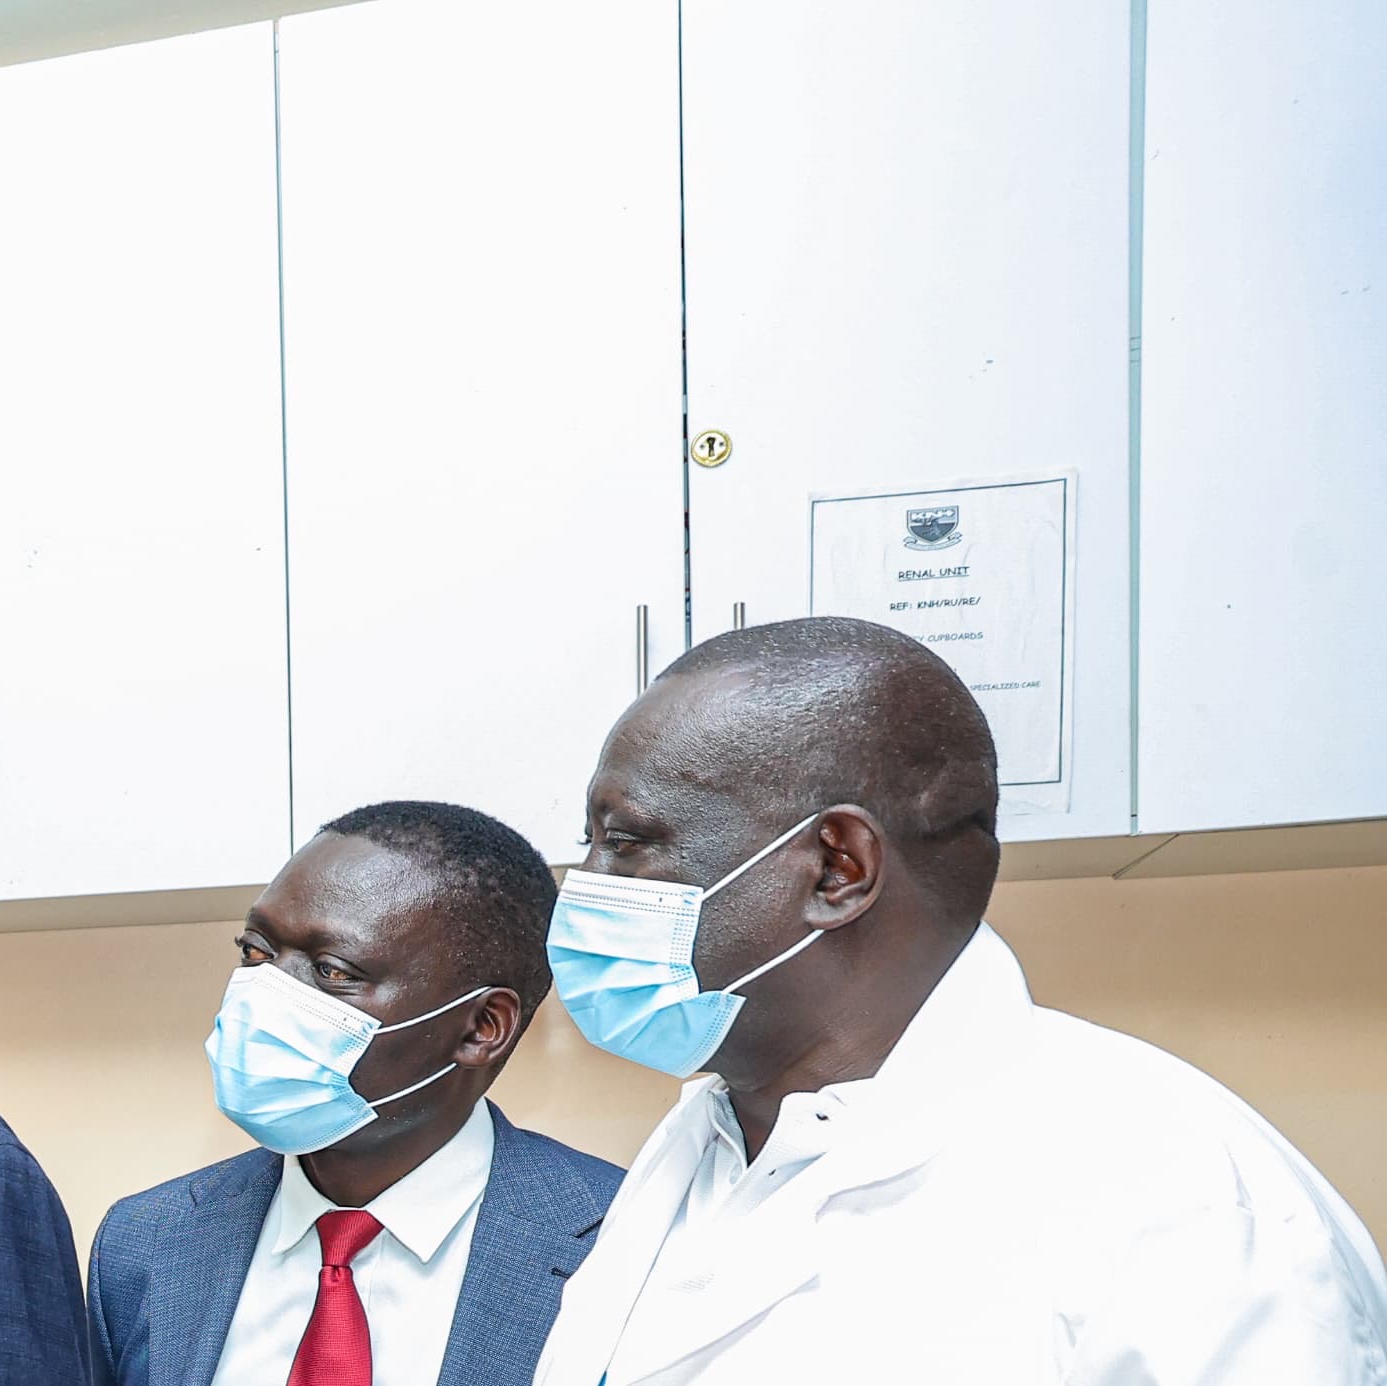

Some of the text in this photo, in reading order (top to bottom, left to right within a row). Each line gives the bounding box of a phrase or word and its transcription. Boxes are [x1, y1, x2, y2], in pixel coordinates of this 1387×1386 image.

[898, 566, 970, 580] RENAL UNIT
[889, 597, 980, 612] REF: KNH/RU/RE/
[927, 631, 984, 643] CUPBOARDS
[1021, 680, 1042, 689] CARE
